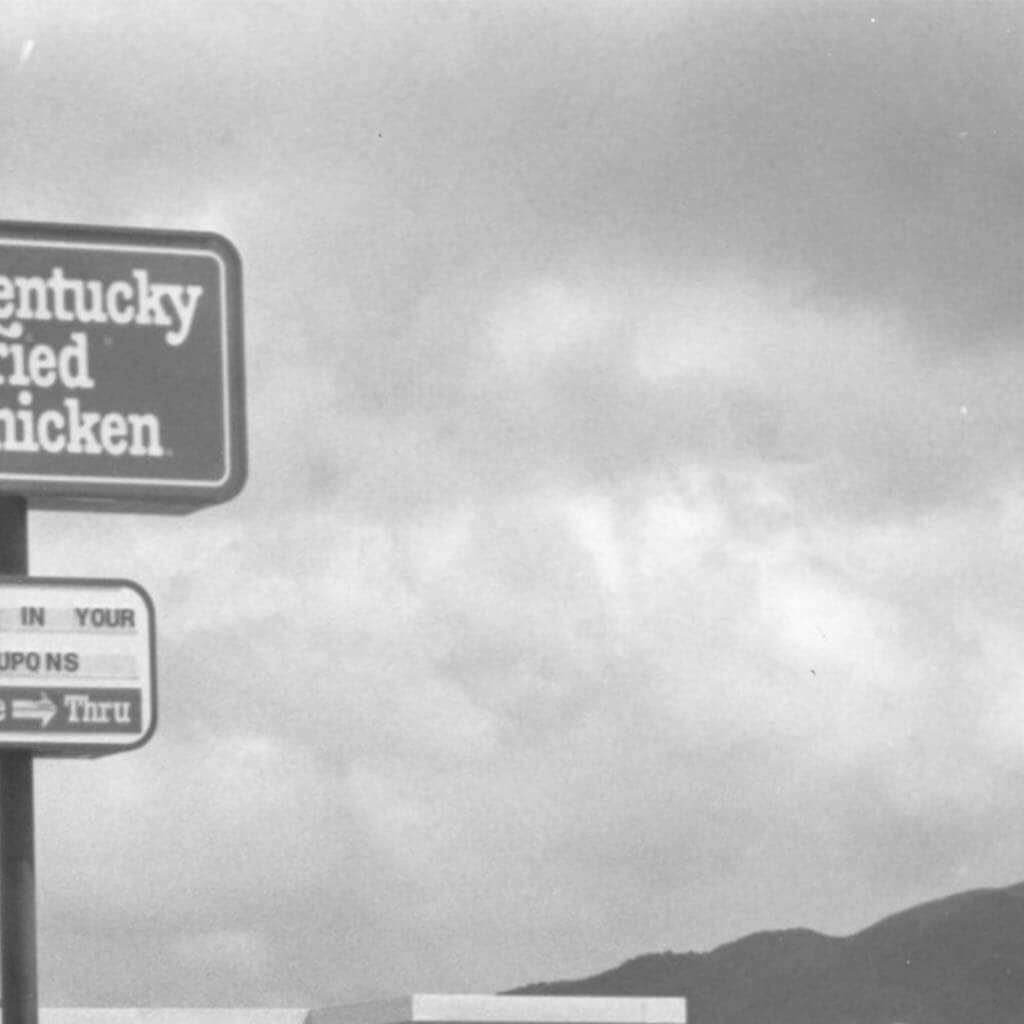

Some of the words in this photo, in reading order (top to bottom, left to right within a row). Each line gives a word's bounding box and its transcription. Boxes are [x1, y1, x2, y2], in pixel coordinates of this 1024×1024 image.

[21, 606, 45, 627] IN
[74, 607, 135, 628] YOUR
[64, 694, 132, 723] Thru
